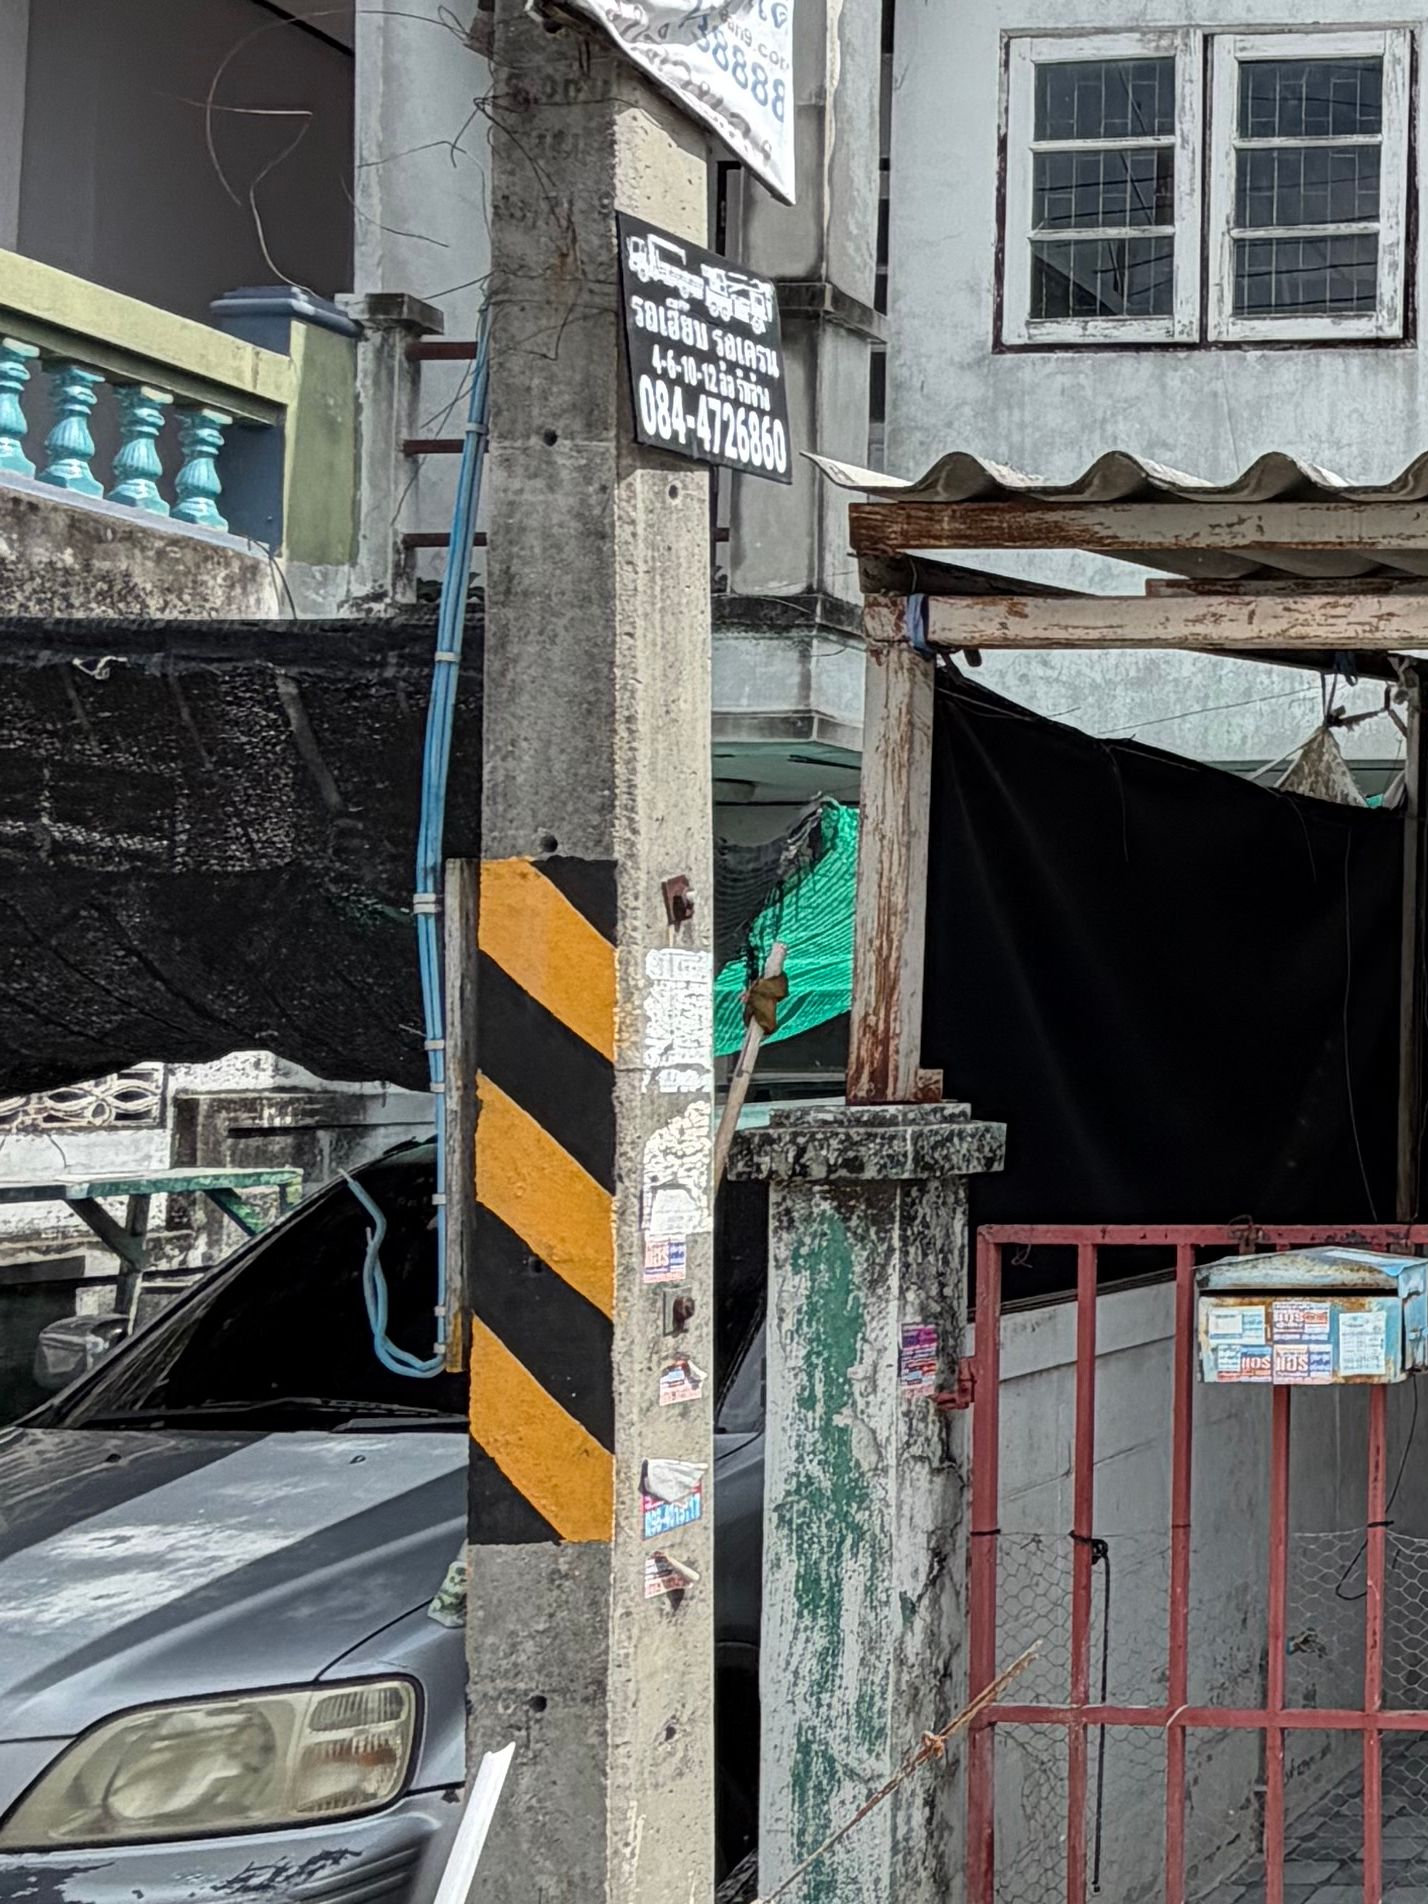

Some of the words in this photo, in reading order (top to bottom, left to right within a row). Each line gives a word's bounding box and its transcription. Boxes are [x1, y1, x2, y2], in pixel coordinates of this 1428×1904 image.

[711, 328, 780, 379] รถเครน
[638, 373, 788, 475] 084-4726860
